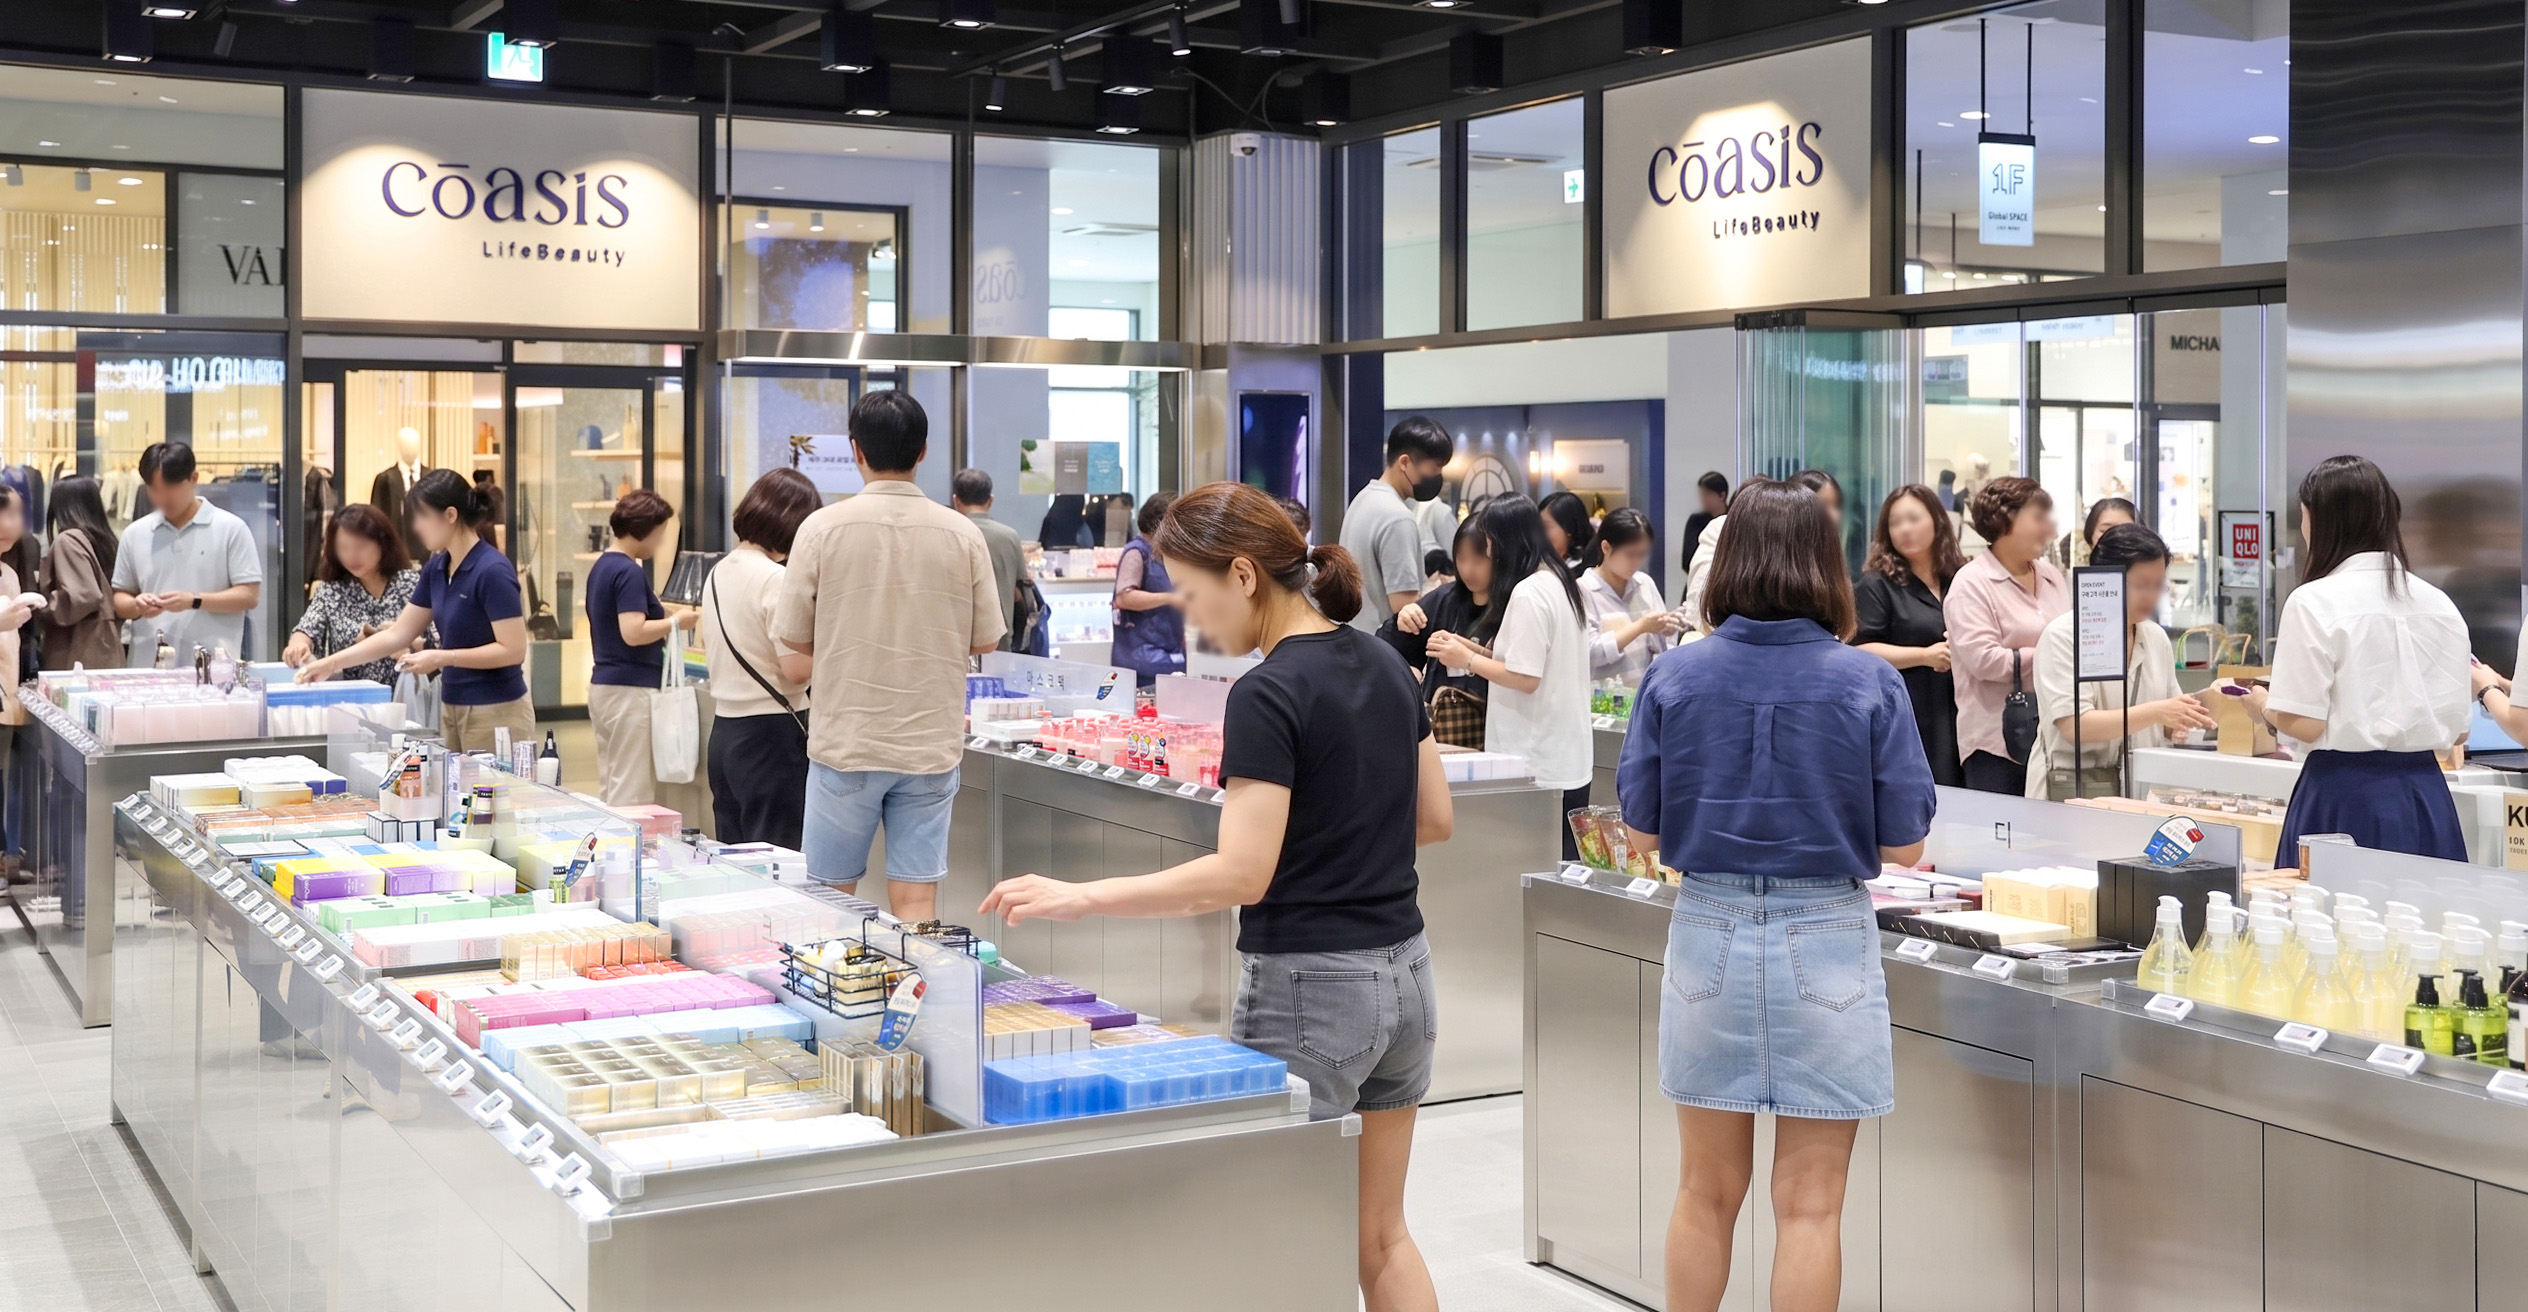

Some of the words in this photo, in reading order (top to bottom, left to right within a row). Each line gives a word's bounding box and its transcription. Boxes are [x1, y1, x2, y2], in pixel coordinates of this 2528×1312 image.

[1992, 163, 2025, 195] 1F
[1713, 210, 1820, 239] LifeBeauty
[1988, 211, 2008, 220] Global
[2009, 212, 2028, 222] SPACE
[483, 240, 624, 267] LifeBeauty
[2170, 335, 2220, 351] MICHA
[2235, 528, 2256, 540] UNI
[2235, 543, 2258, 556] QLO
[2508, 805, 2528, 828] K
